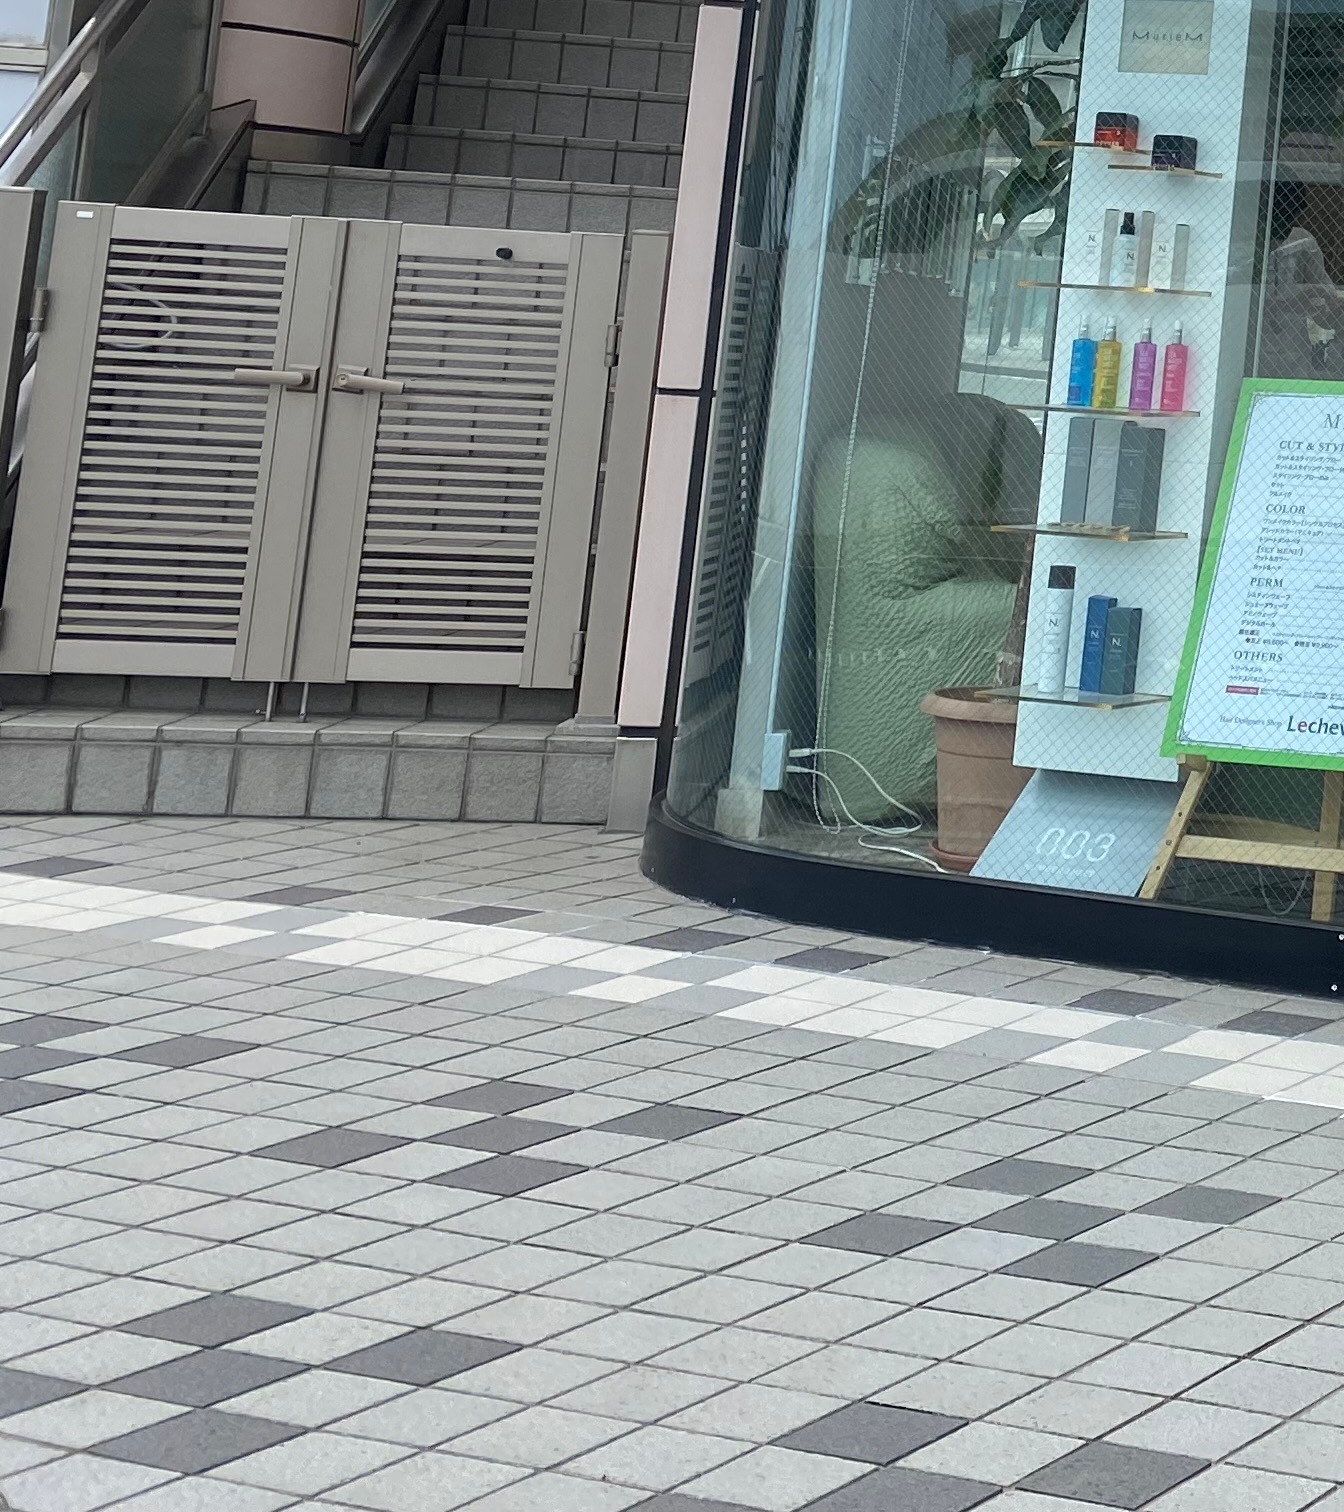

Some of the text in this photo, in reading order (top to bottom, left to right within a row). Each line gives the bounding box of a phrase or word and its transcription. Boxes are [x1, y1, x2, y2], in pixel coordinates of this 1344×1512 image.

[1279, 440, 1303, 450] CUT
[1265, 503, 1306, 515] COLOR
[1250, 577, 1284, 588] PERM
[1234, 650, 1284, 662] OTHERS
[1035, 828, 1117, 863] 003
